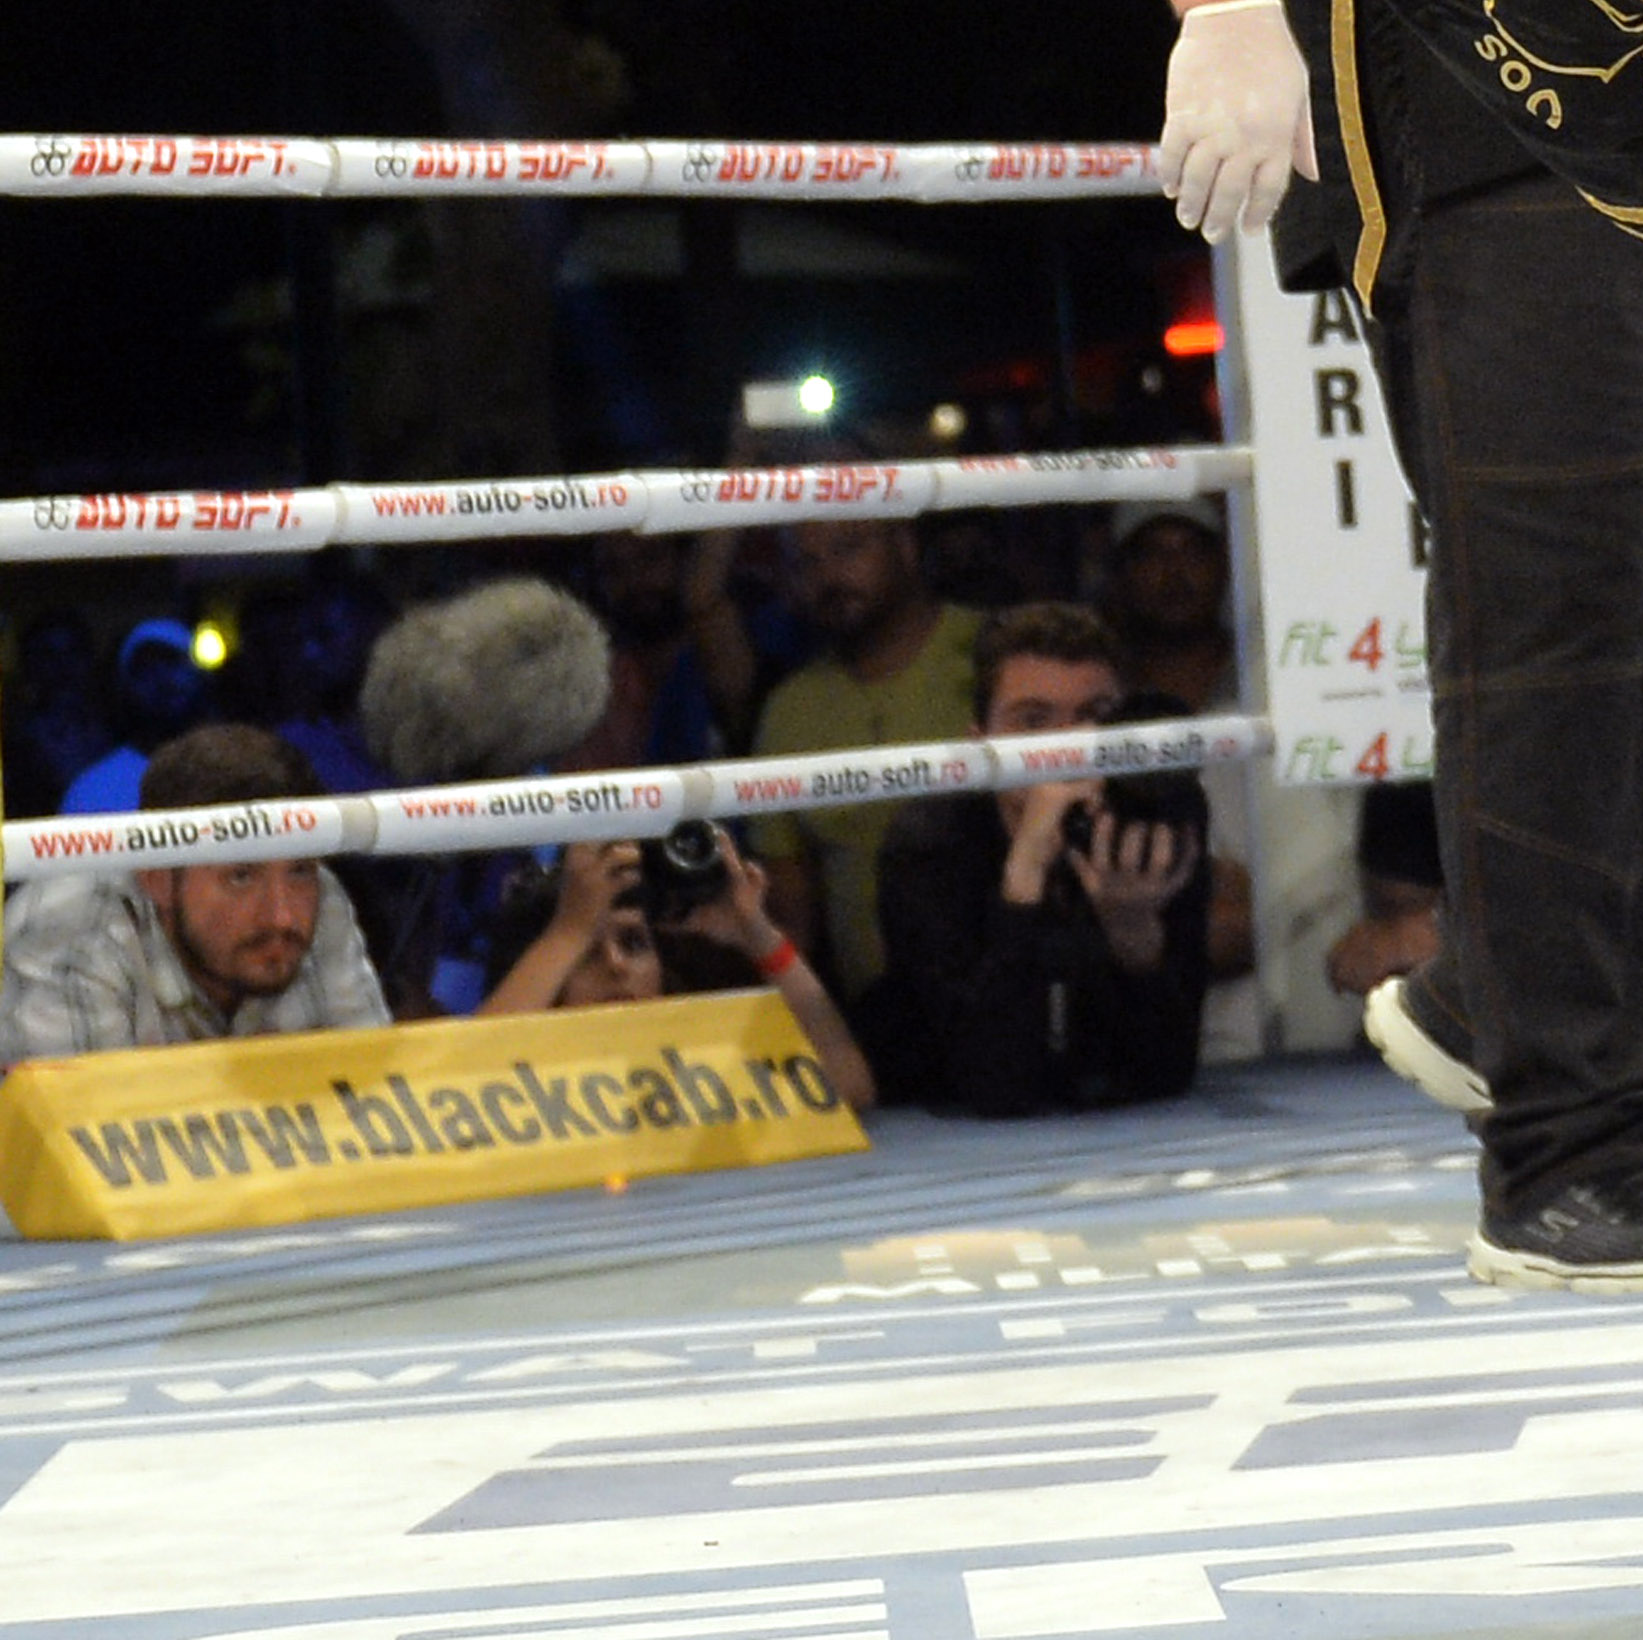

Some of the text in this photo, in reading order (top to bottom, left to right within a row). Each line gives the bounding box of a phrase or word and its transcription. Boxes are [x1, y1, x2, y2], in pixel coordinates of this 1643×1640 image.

[1347, 615, 1385, 672] 4
[1354, 731, 1391, 780] 4
[31, 808, 317, 859] www.auto-soft.ro
[70, 1048, 840, 1189] www.blackcab.ro
